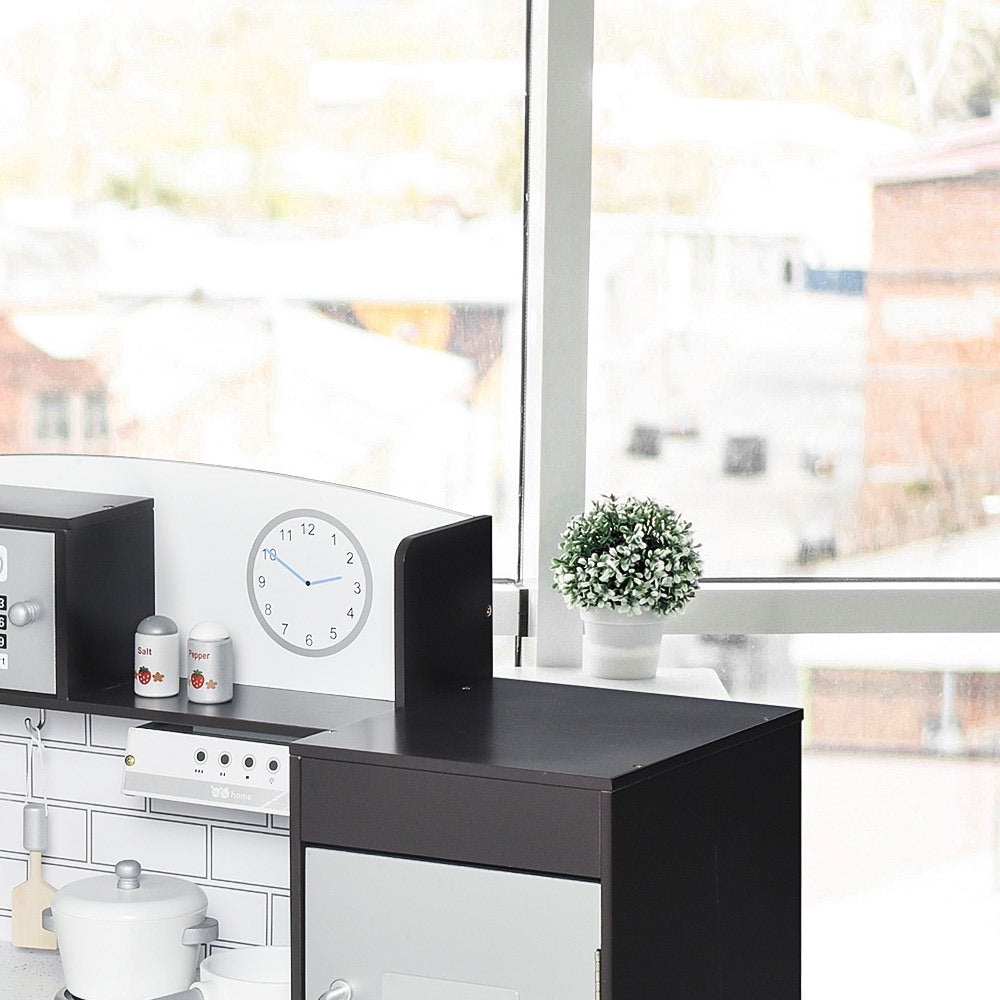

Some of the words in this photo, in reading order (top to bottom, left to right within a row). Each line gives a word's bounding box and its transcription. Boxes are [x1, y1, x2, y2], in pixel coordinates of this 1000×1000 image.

[280, 529, 292, 541] 11
[301, 523, 315, 536] 12
[331, 534, 336, 545] 1
[262, 548, 276, 561] 10
[346, 552, 354, 564] 2
[258, 575, 266, 588] 9
[353, 582, 361, 594] 3
[264, 603, 272, 615] 8
[346, 607, 354, 619] 4
[281, 623, 288, 635] 7
[329, 627, 337, 640] 5
[305, 634, 313, 646] 6
[137, 646, 152, 656] Salt
[188, 649, 210, 660] Pepper
